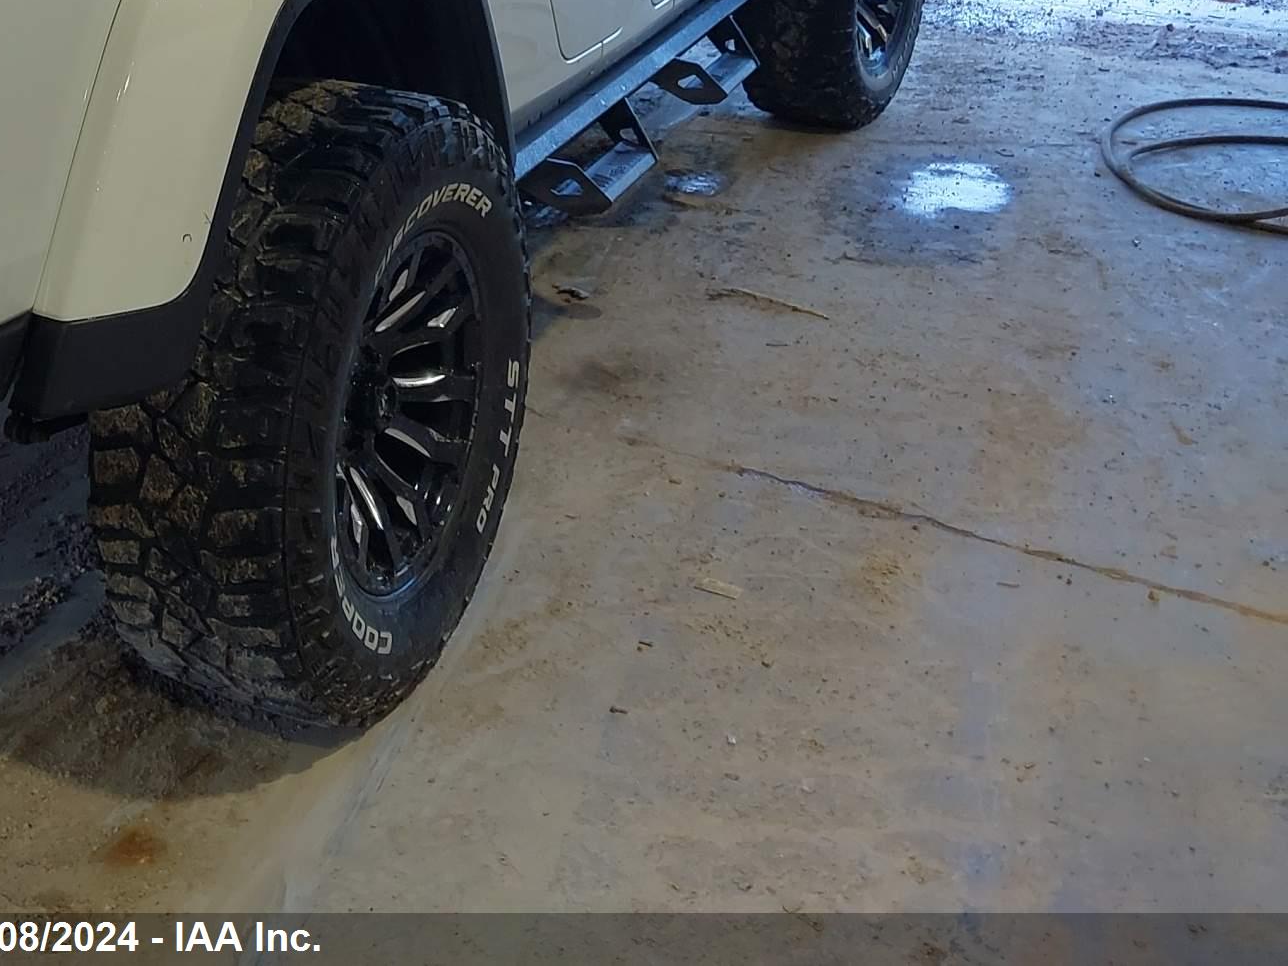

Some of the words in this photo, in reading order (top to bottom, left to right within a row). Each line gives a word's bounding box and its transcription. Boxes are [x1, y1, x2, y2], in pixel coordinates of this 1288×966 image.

[373, 182, 493, 291] DISCOVERER
[498, 357, 520, 457] STT
[475, 462, 500, 533] PRO
